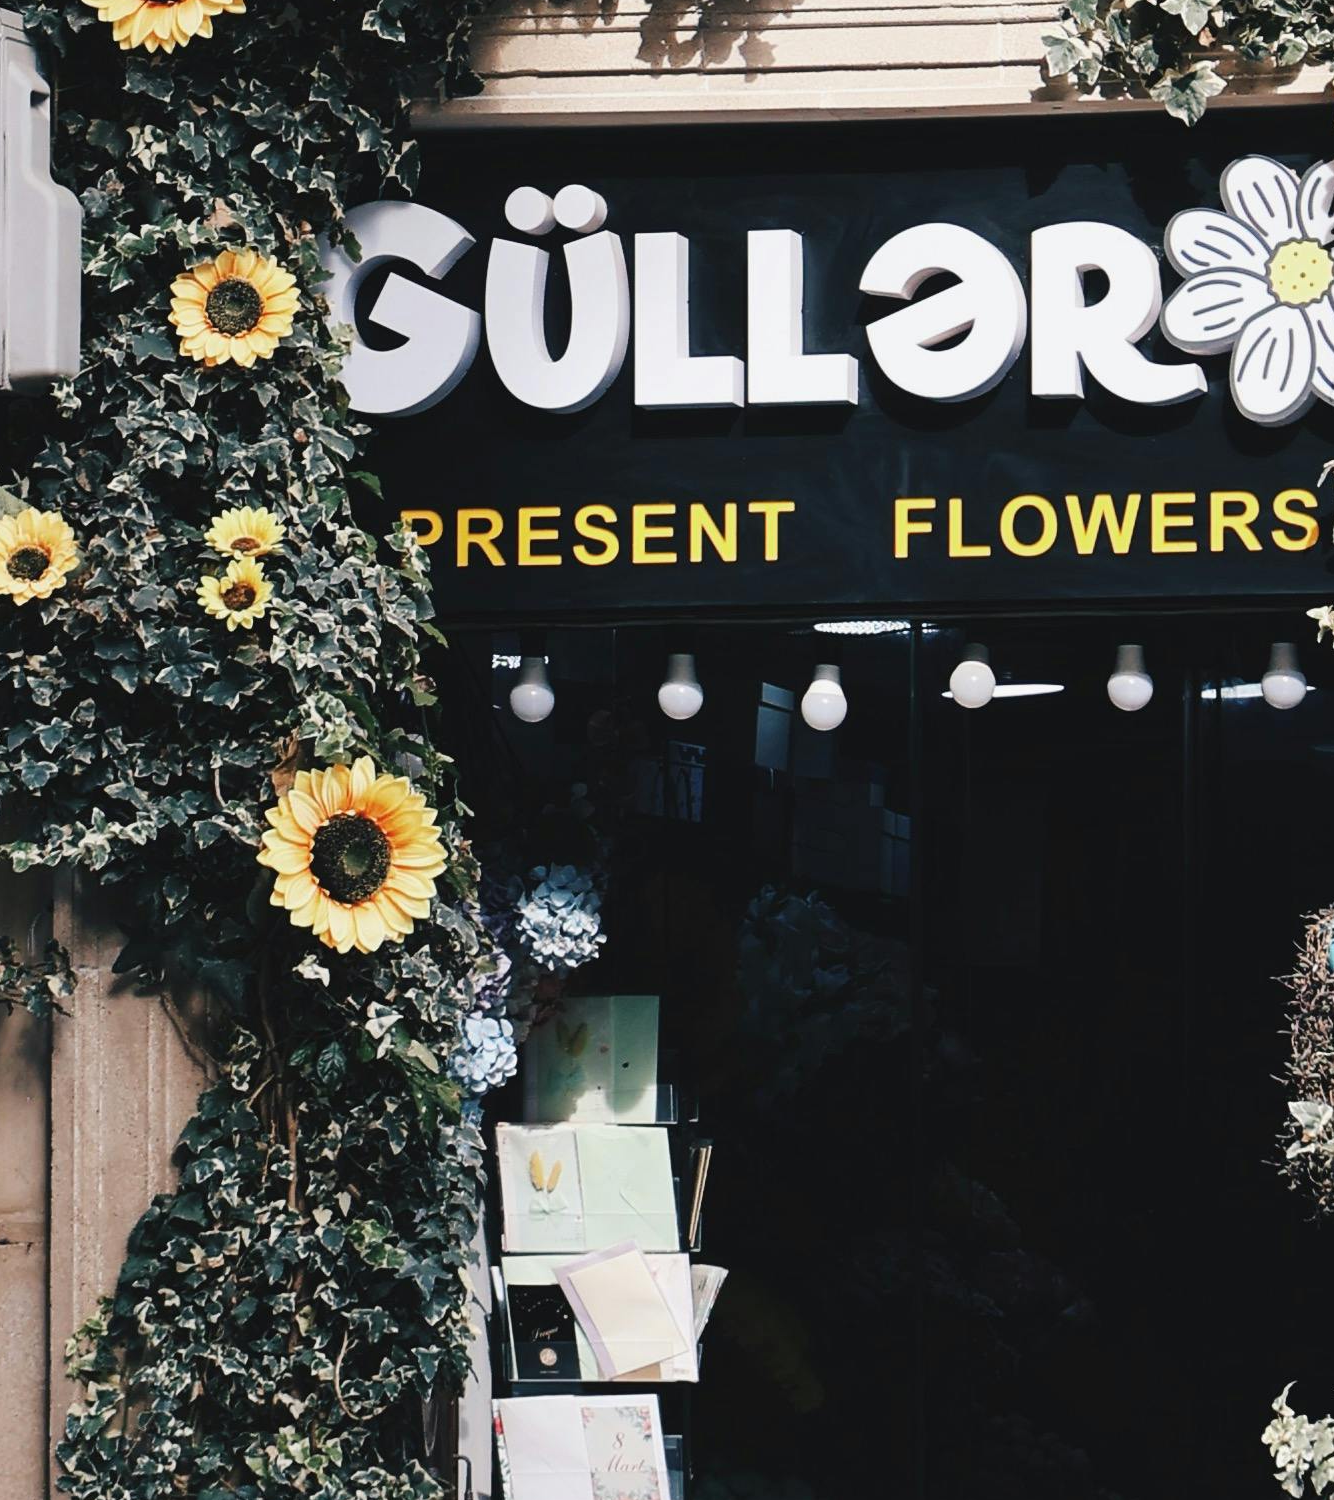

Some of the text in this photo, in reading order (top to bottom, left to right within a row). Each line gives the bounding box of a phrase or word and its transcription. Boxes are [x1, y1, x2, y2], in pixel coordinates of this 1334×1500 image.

[315, 183, 1208, 416] GÜLLƏR
[402, 488, 1320, 568] PRESENT FLOWERS
